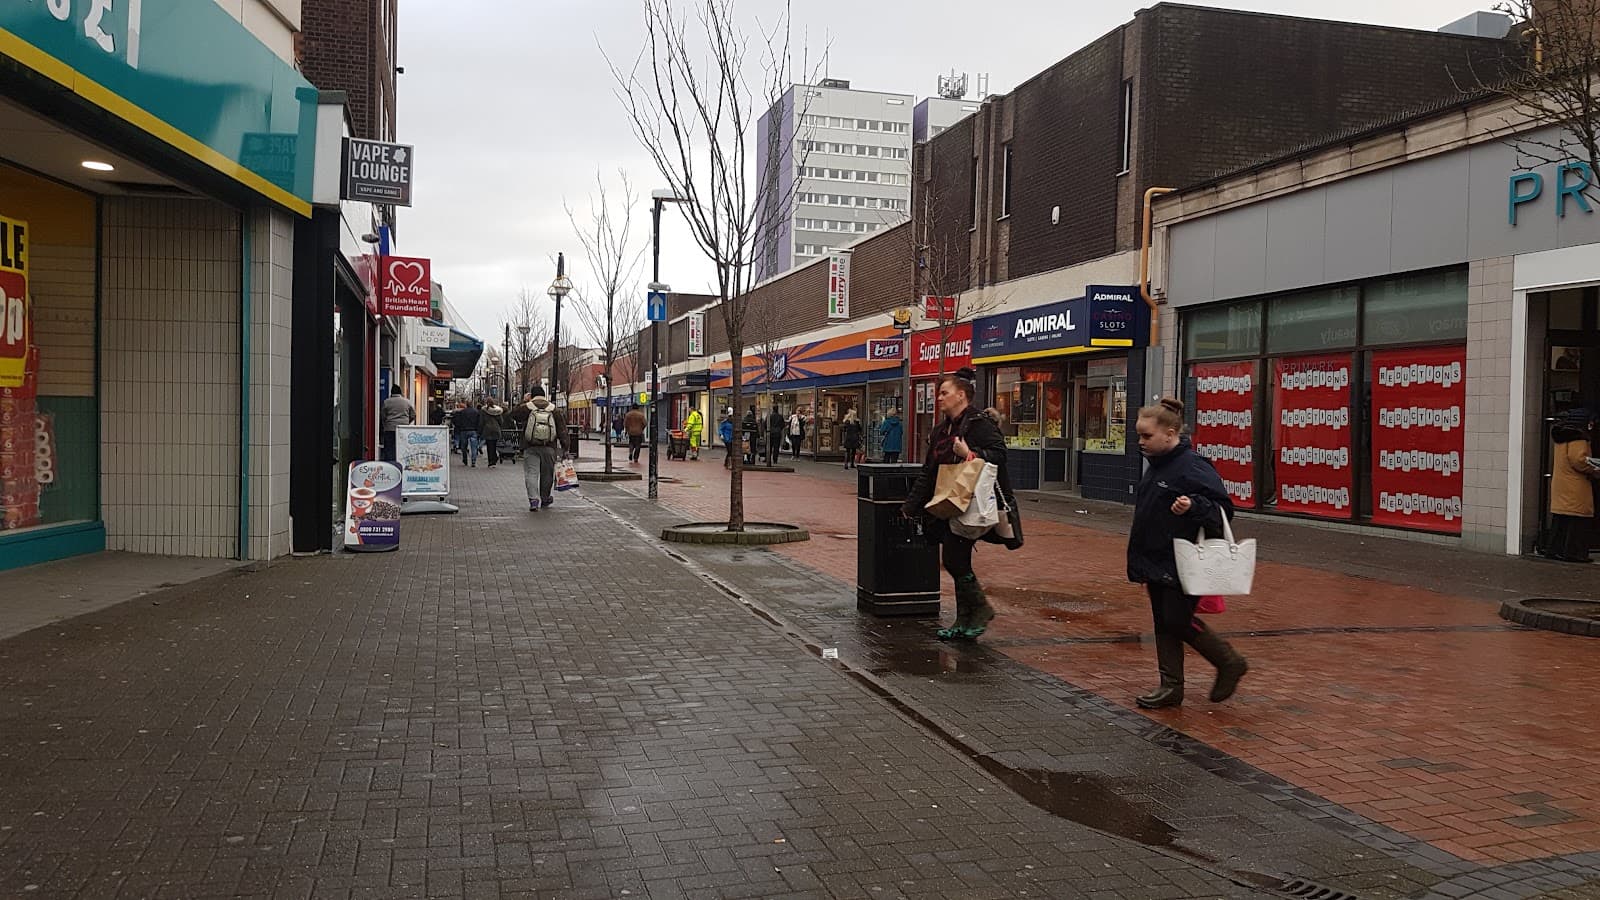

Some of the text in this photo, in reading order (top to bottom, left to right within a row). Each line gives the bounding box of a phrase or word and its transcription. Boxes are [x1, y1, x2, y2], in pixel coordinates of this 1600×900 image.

[352, 142, 390, 164] VAPE
[351, 161, 409, 184] LOUNGE
[836, 258, 846, 314] cherrytree
[408, 298, 428, 306] Heart
[1093, 293, 1134, 302] ADMIRAL
[384, 303, 428, 313] Foundation
[1014, 309, 1076, 339] ADMIRAL
[1099, 321, 1126, 329] SLOTS
[920, 339, 972, 363] Supenews
[1282, 371, 1347, 388] REDUCTIONS
[1380, 366, 1460, 384] REDUCTIONS
[1282, 411, 1347, 426] REDUCTIONS
[1380, 409, 1459, 428] REDUCTIONS
[1282, 449, 1347, 466] REDUCTIONS
[1380, 453, 1459, 473] REDUCTIONS
[1282, 486, 1349, 506] REDUCTIONS
[1380, 494, 1461, 516] REDUCTIONS
